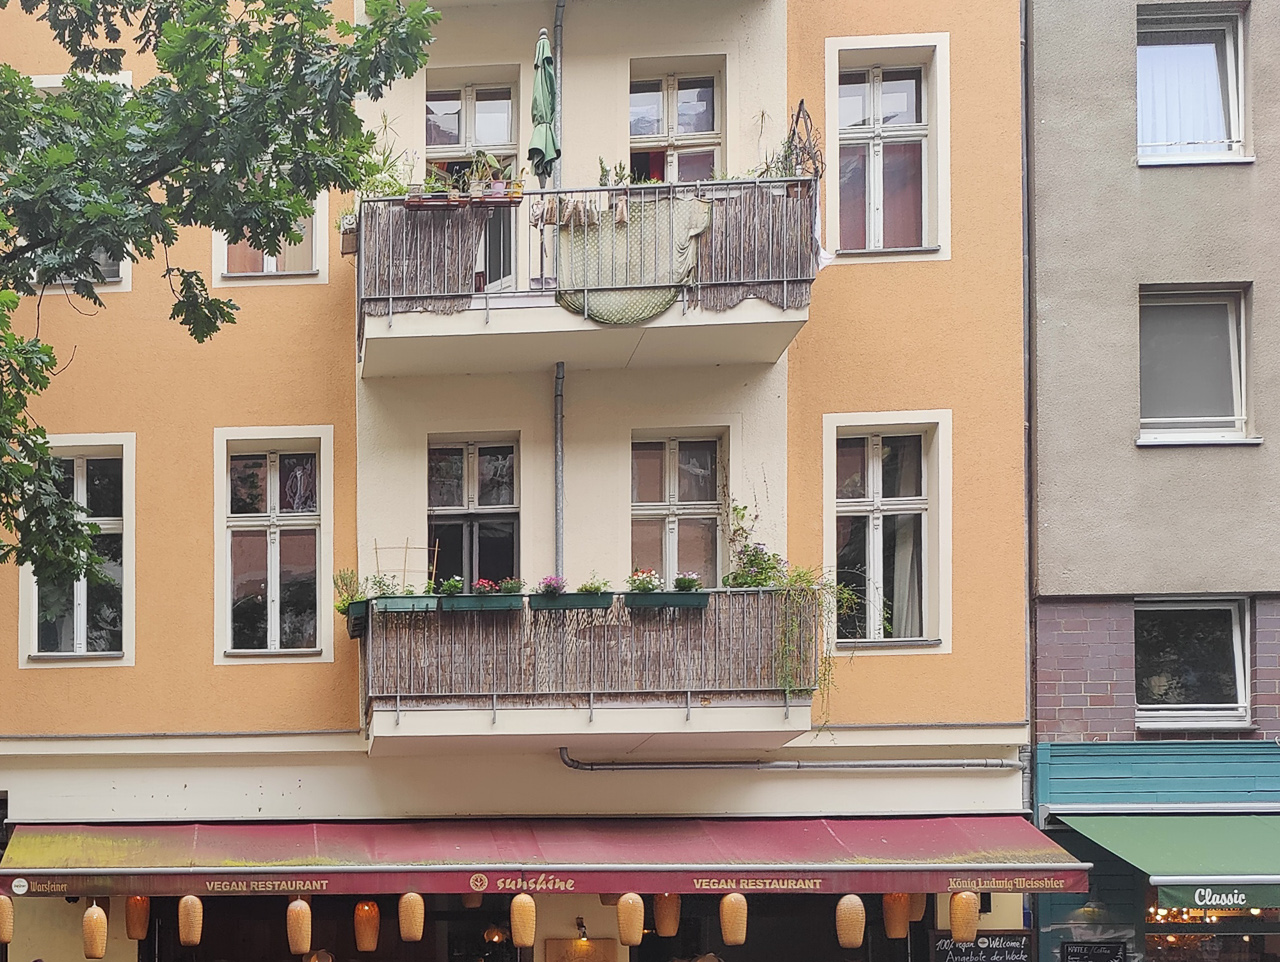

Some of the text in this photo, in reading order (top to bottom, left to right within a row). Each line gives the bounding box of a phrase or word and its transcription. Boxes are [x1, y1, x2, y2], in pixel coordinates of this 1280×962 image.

[30, 881, 68, 894] Warsteiner
[206, 880, 329, 891] VEGAN RESTAURANT
[497, 876, 575, 891] sunshine
[693, 879, 822, 889] VEGAN RESTAURANT
[948, 878, 1065, 891] König Ludwig Weissbier
[1194, 888, 1246, 905] Classic
[955, 941, 975, 953] vegan
[989, 937, 1027, 949] Welcome!
[990, 951, 1004, 961] der
[1005, 950, 1028, 961] Woche
